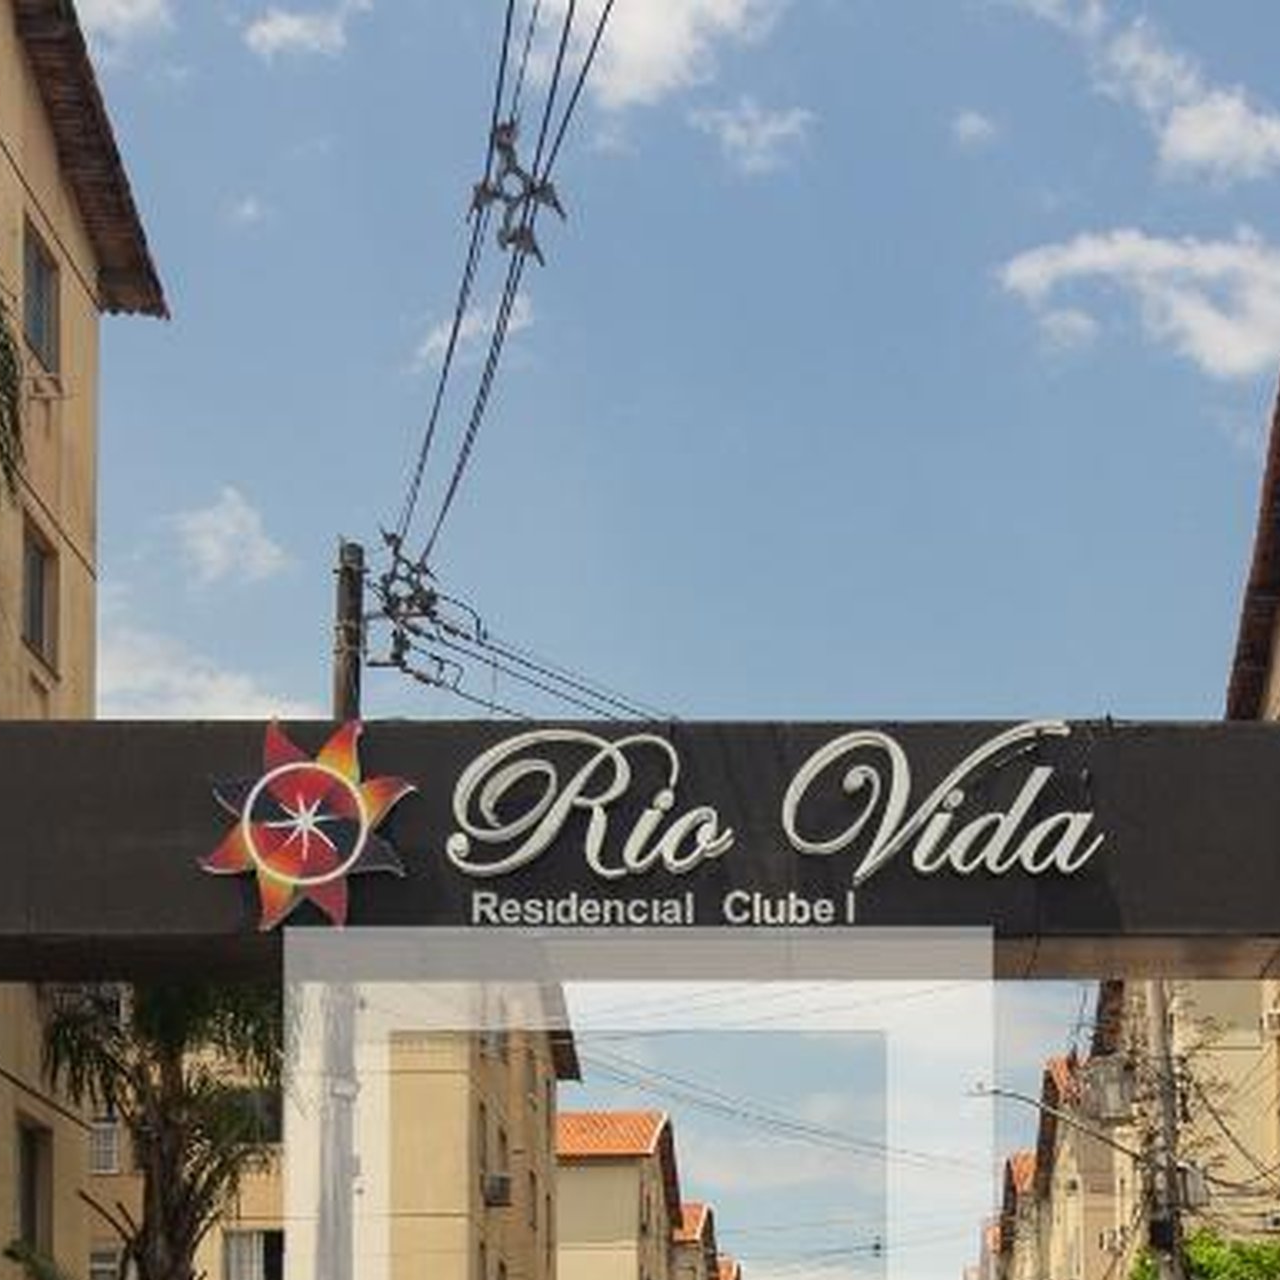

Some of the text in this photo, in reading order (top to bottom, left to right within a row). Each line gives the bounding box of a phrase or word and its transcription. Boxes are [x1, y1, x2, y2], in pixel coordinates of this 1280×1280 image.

[446, 719, 1104, 886] Rio Vida
[471, 891, 695, 925] Residencial
[723, 890, 835, 925] Clube
